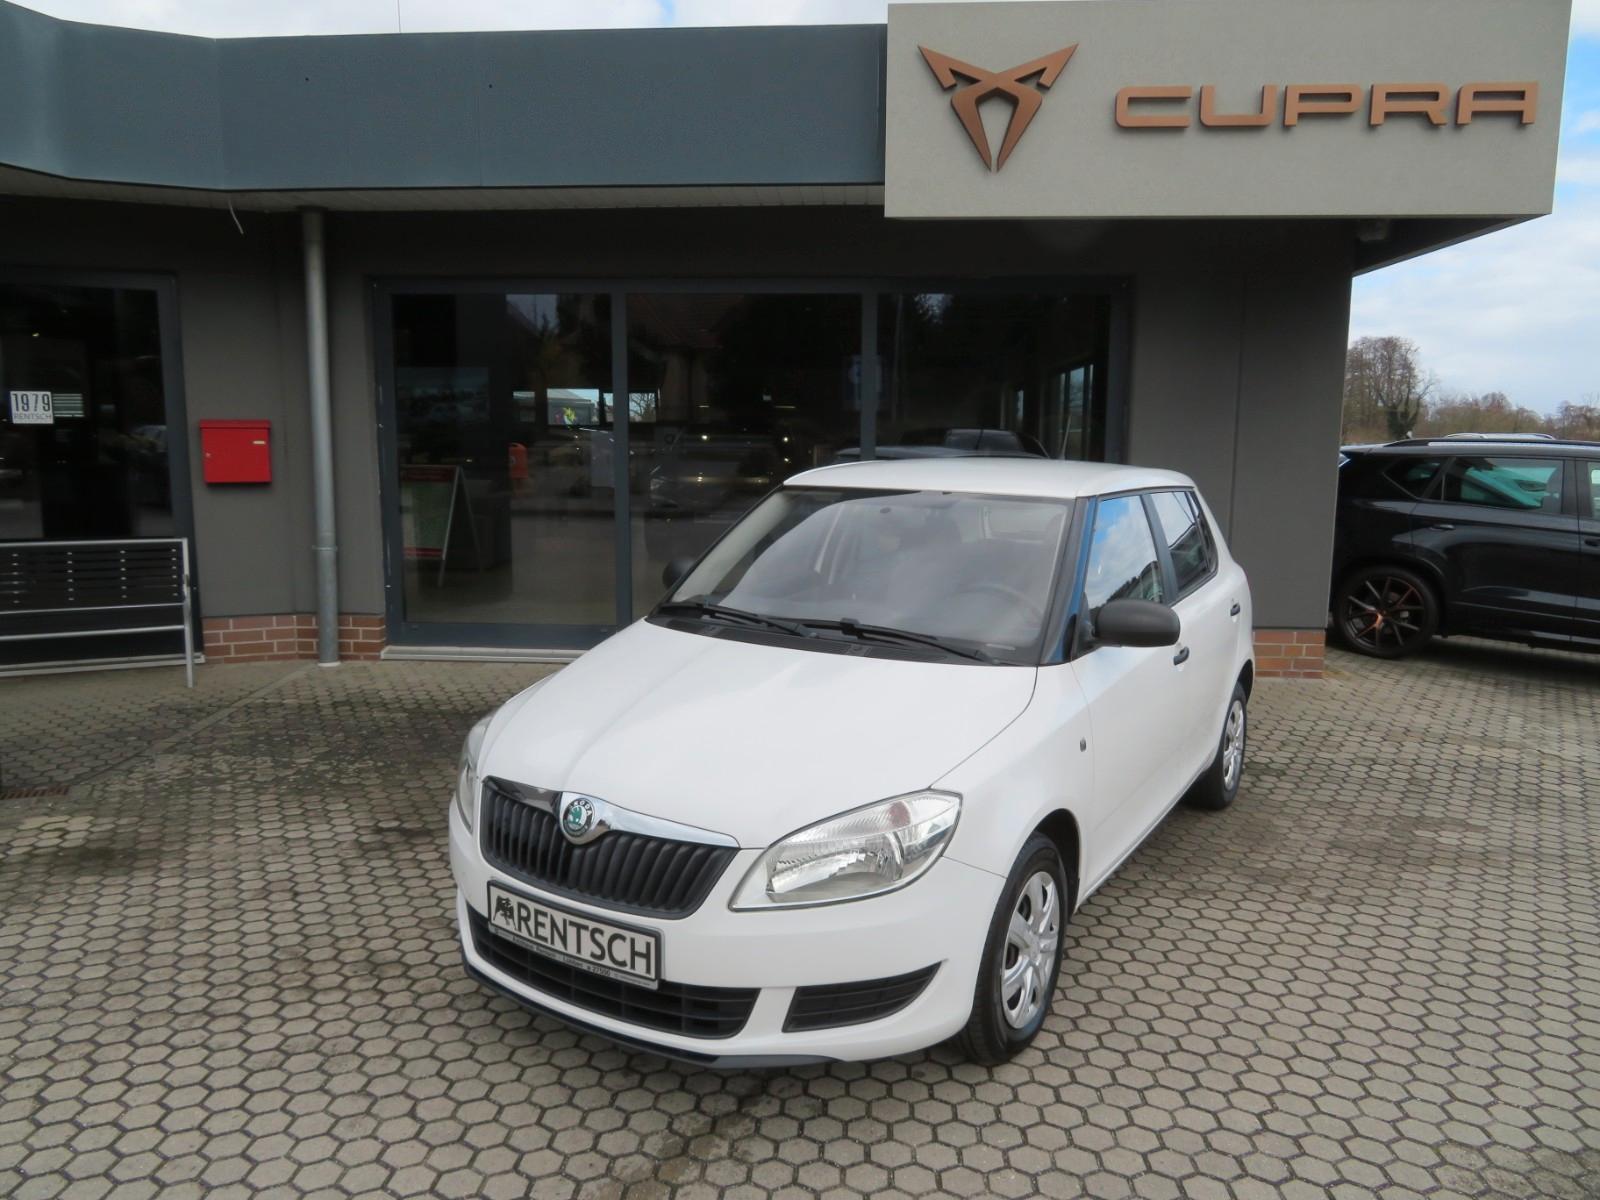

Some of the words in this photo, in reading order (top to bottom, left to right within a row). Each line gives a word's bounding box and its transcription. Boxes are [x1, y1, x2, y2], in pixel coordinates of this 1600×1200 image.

[1115, 82, 1538, 127] CUPRA
[11, 393, 51, 412] 1979
[517, 902, 652, 975] RENTSCH
